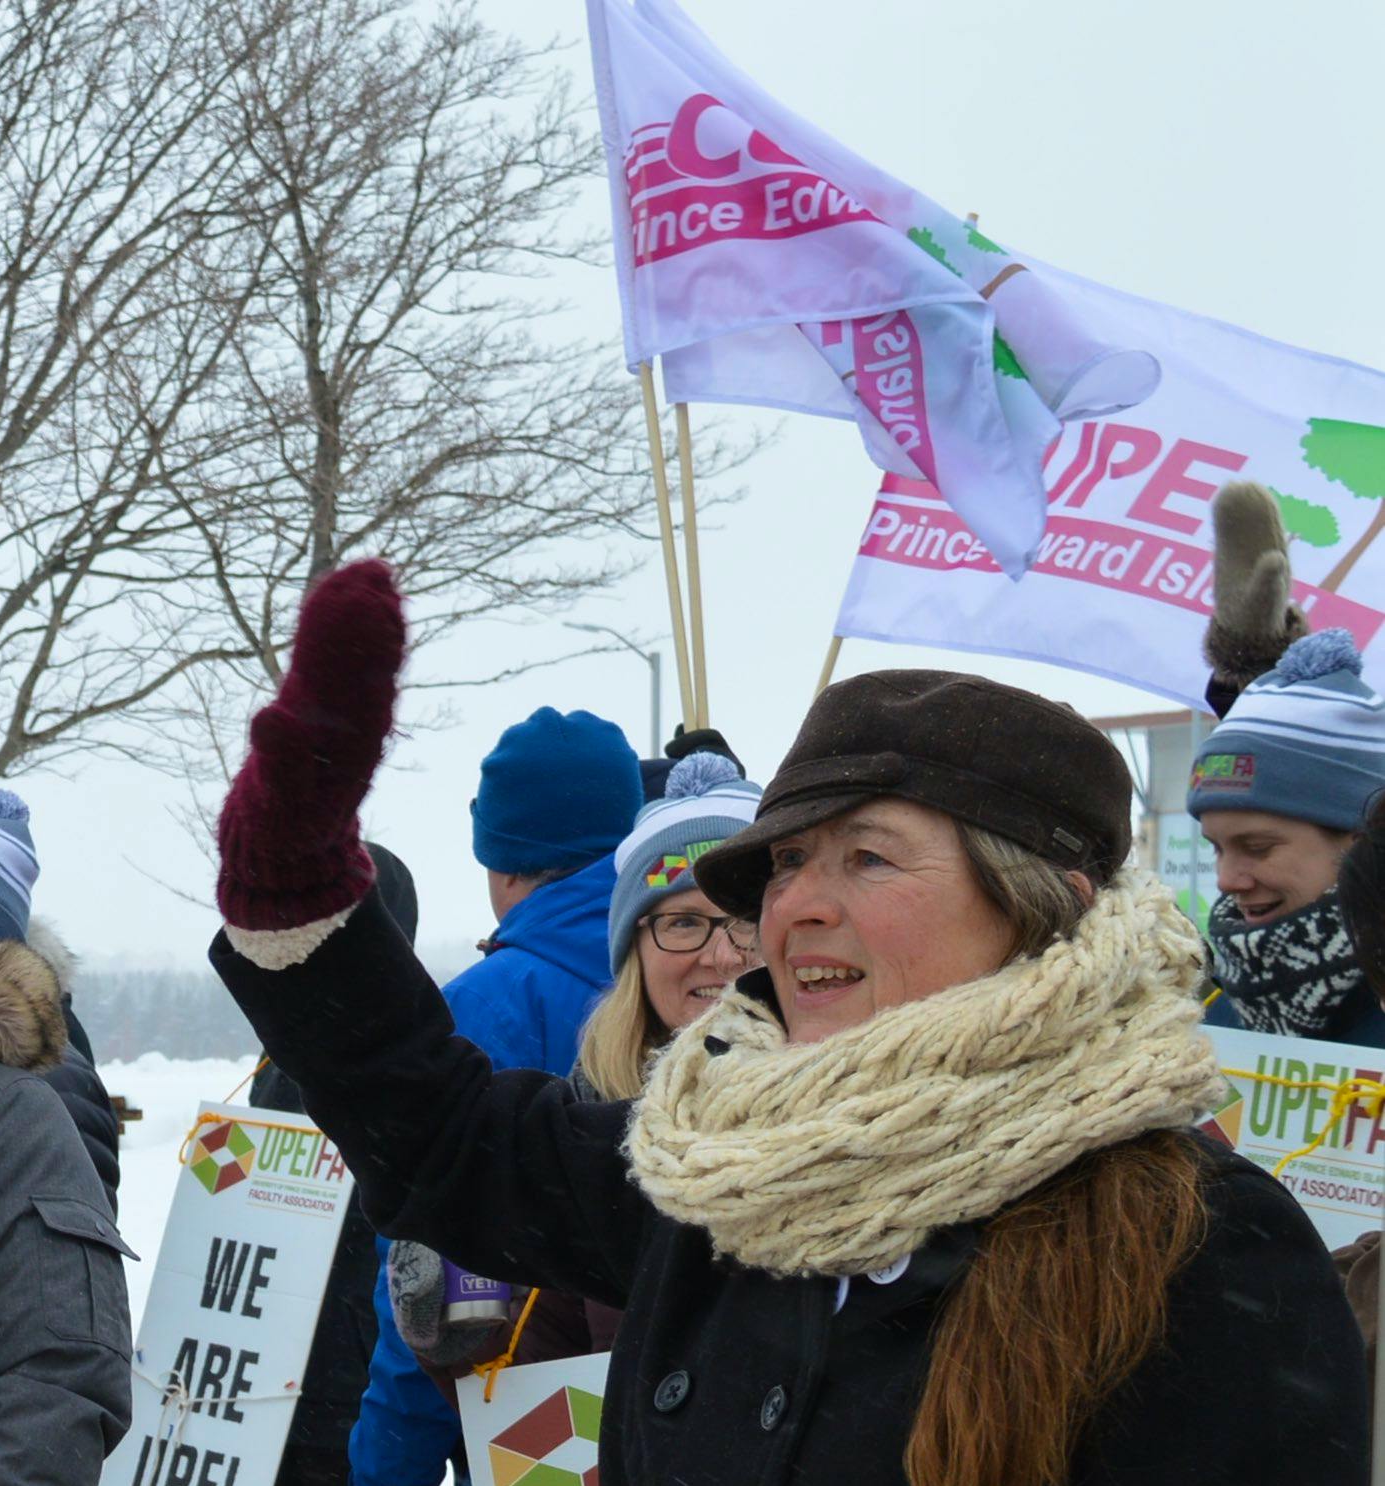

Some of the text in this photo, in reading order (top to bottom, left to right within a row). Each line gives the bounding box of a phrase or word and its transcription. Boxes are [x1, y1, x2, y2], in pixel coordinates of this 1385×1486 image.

[1041, 422, 1249, 536] UPE
[1035, 533, 1143, 580] ward
[200, 1236, 277, 1319] WE
[161, 1337, 259, 1424] ARE
